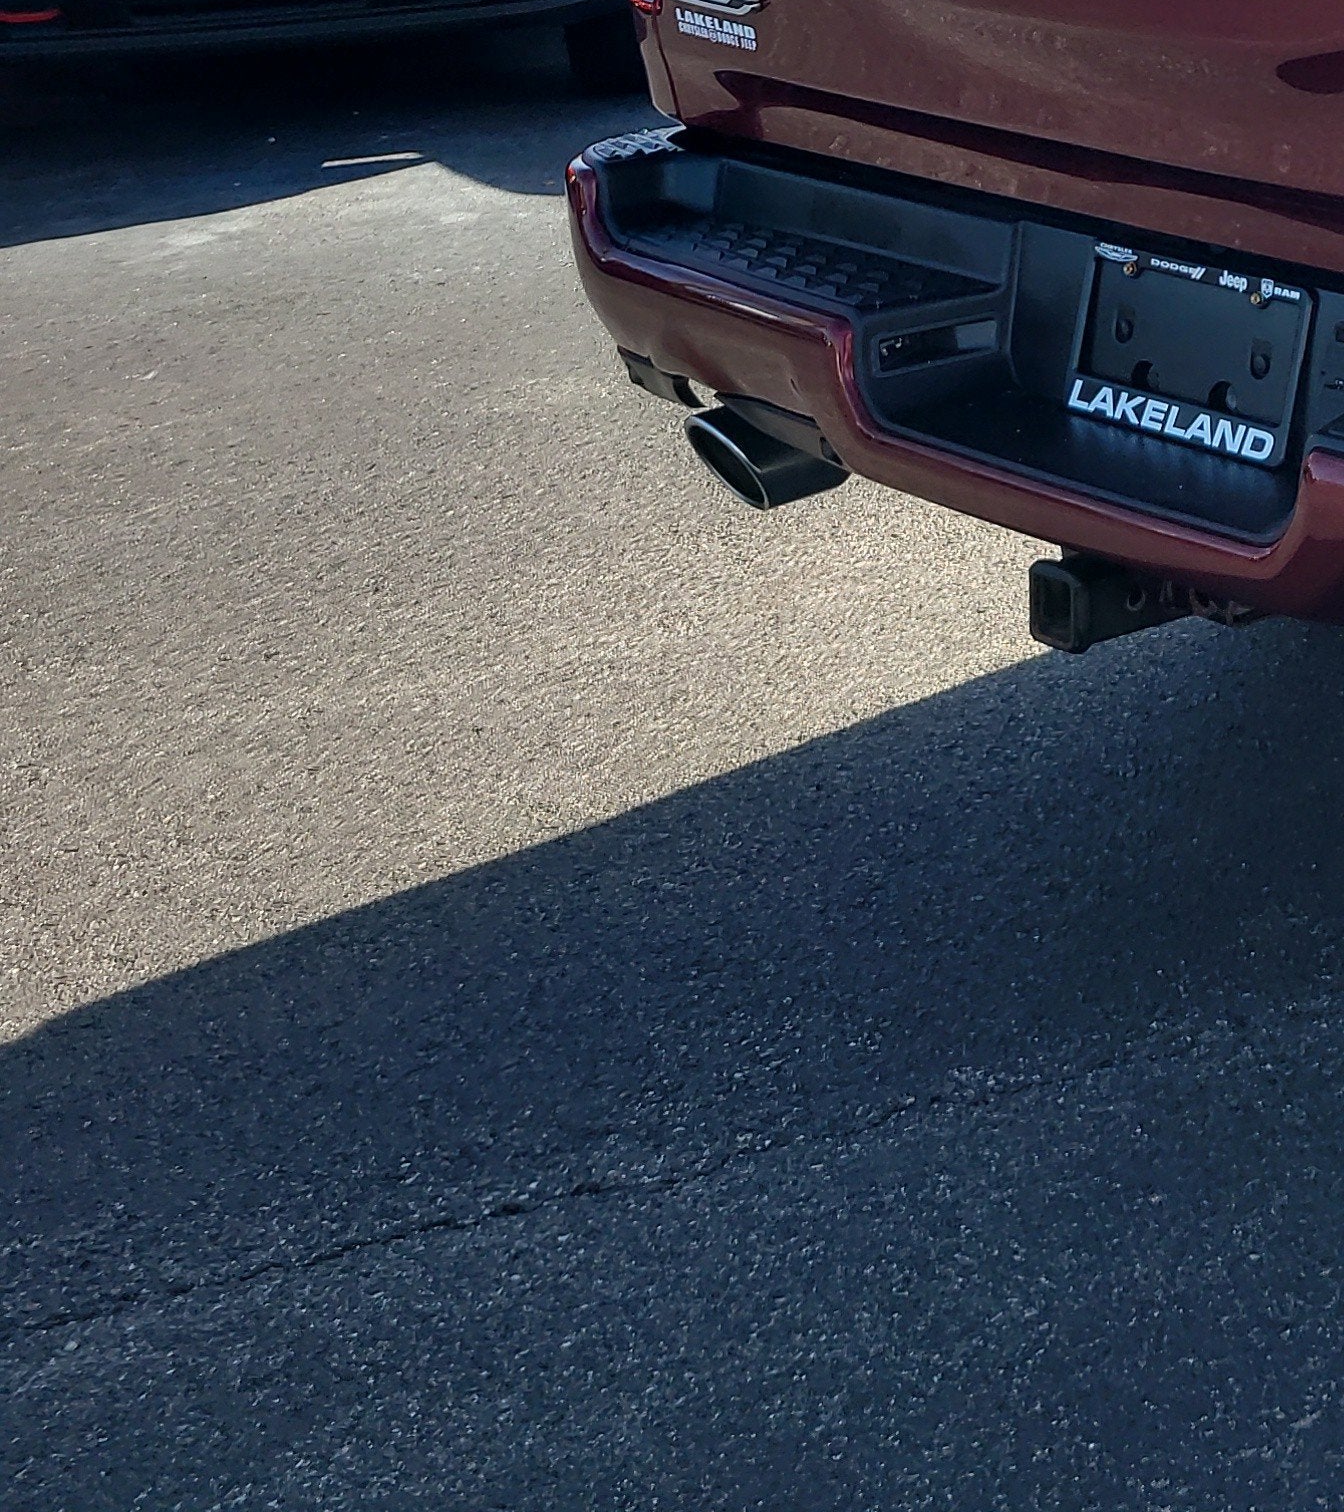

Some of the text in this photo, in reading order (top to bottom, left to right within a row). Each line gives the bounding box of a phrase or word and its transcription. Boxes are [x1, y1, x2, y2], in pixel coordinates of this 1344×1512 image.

[675, 7, 757, 39] LAKELAND
[1150, 257, 1198, 275] DODGE
[1218, 269, 1248, 293] Jeep
[1273, 286, 1301, 300] RAM
[1067, 378, 1275, 462] LAKELAND
